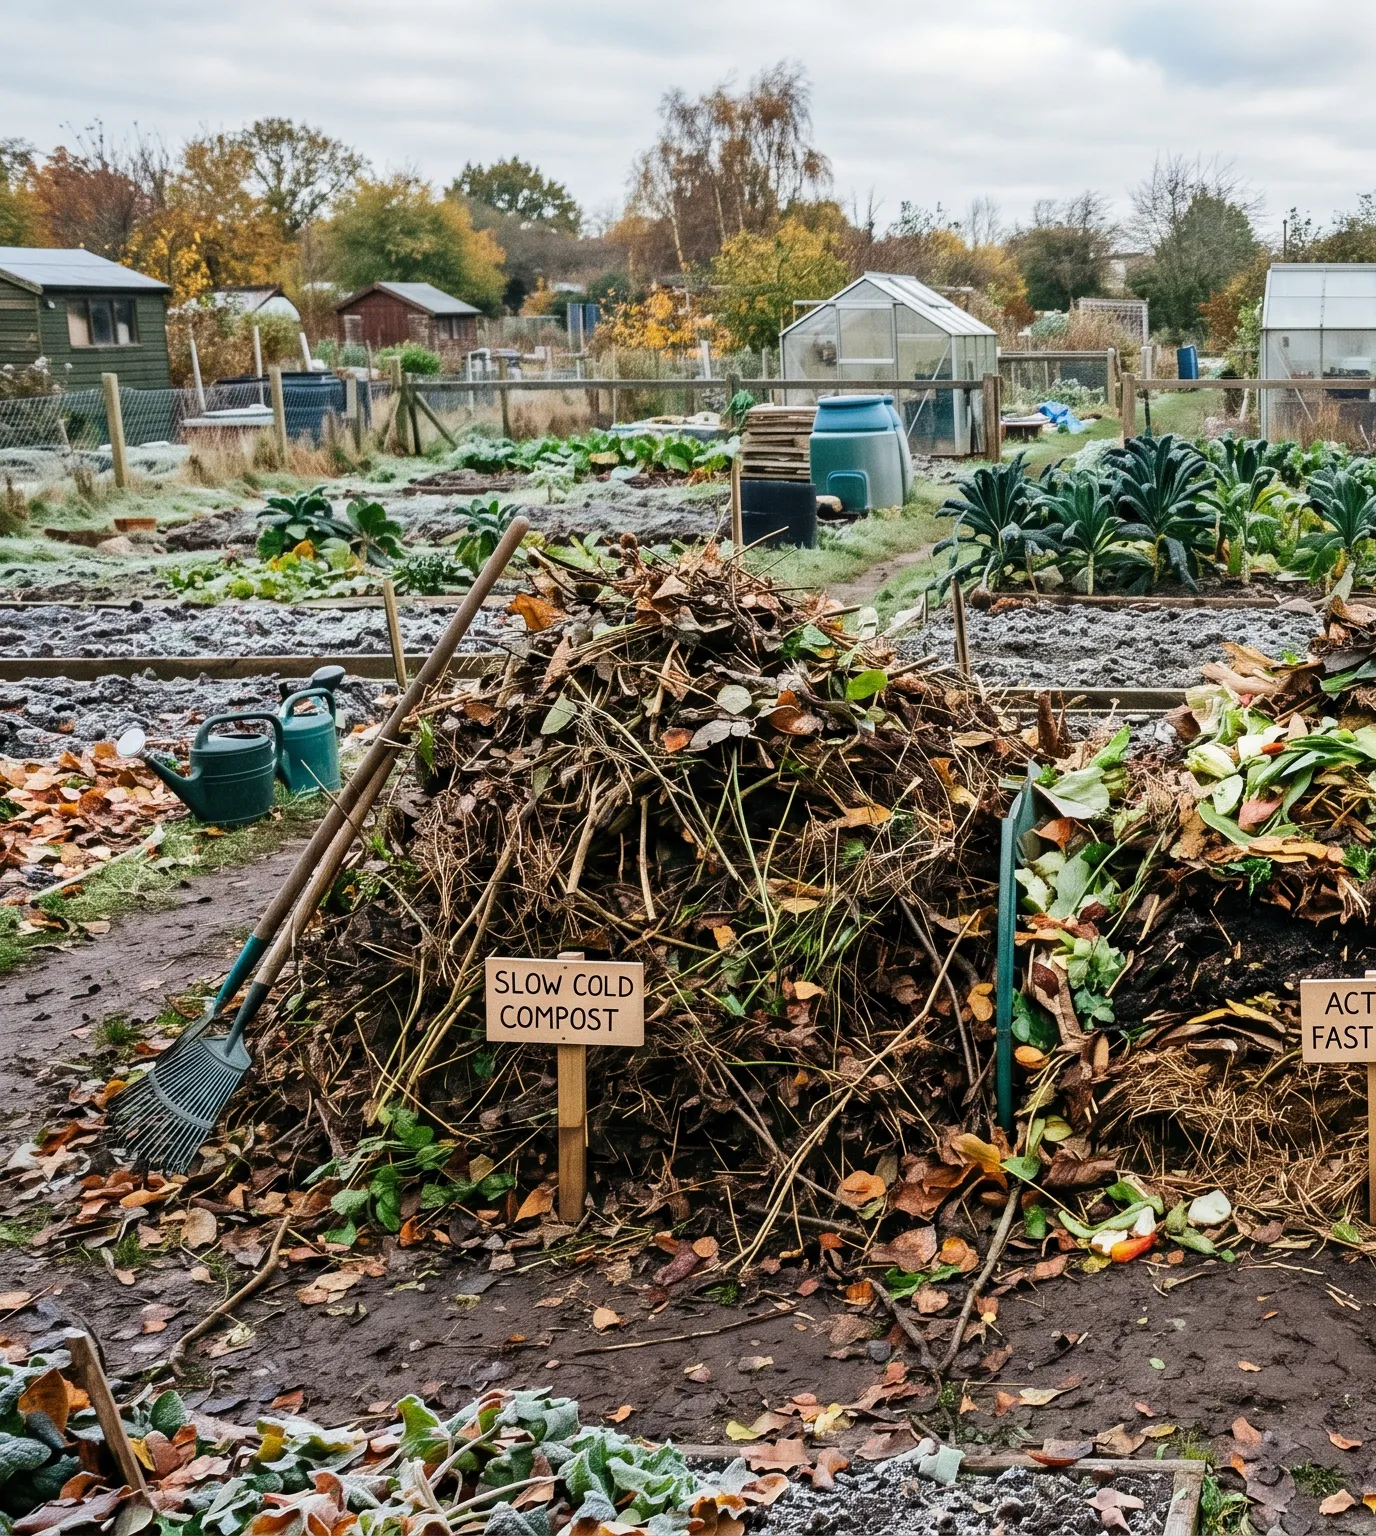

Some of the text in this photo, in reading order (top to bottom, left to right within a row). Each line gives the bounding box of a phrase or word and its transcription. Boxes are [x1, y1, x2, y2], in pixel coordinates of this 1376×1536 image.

[494, 970, 634, 997] SLOW COLD
[500, 1005, 619, 1031] COMPOST
[1312, 1025, 1373, 1049] FAST
